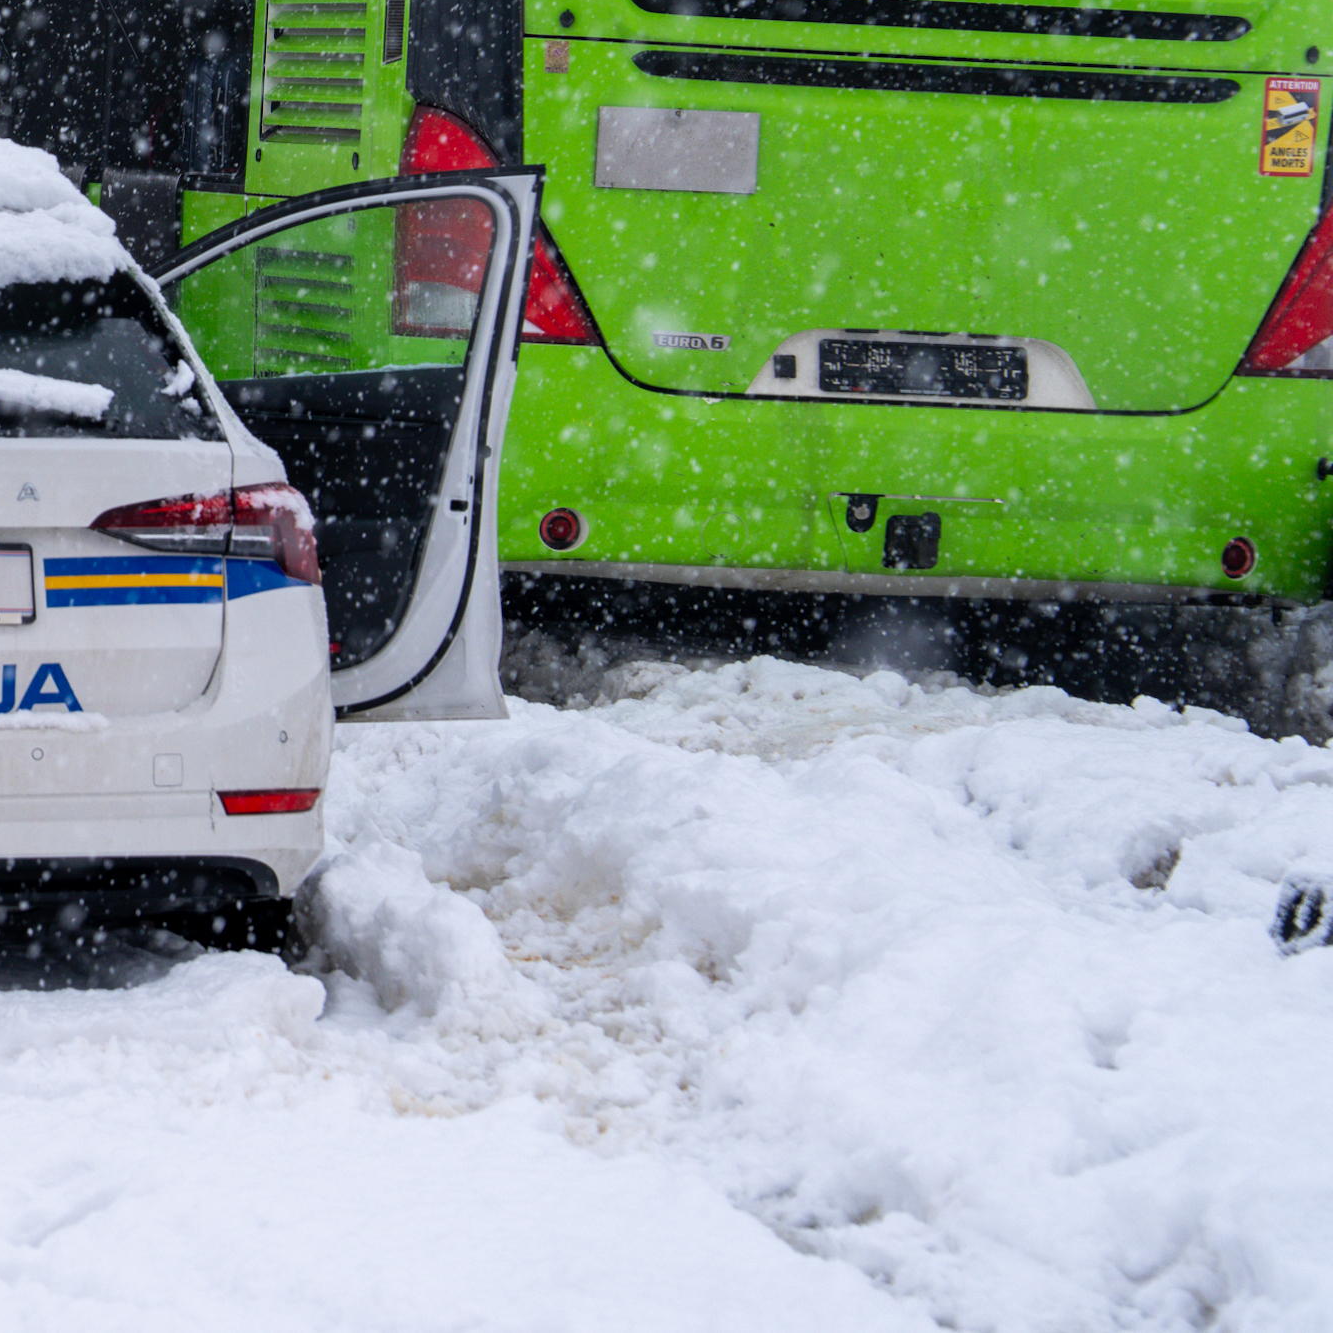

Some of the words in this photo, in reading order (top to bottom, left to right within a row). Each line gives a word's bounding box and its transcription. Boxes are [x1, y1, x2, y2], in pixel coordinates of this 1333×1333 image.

[1269, 79, 1320, 91] ATTENTION
[1270, 147, 1309, 158] ANGLES
[1271, 158, 1306, 168] MORTS
[658, 335, 703, 349] EURO
[711, 336, 724, 350] 6
